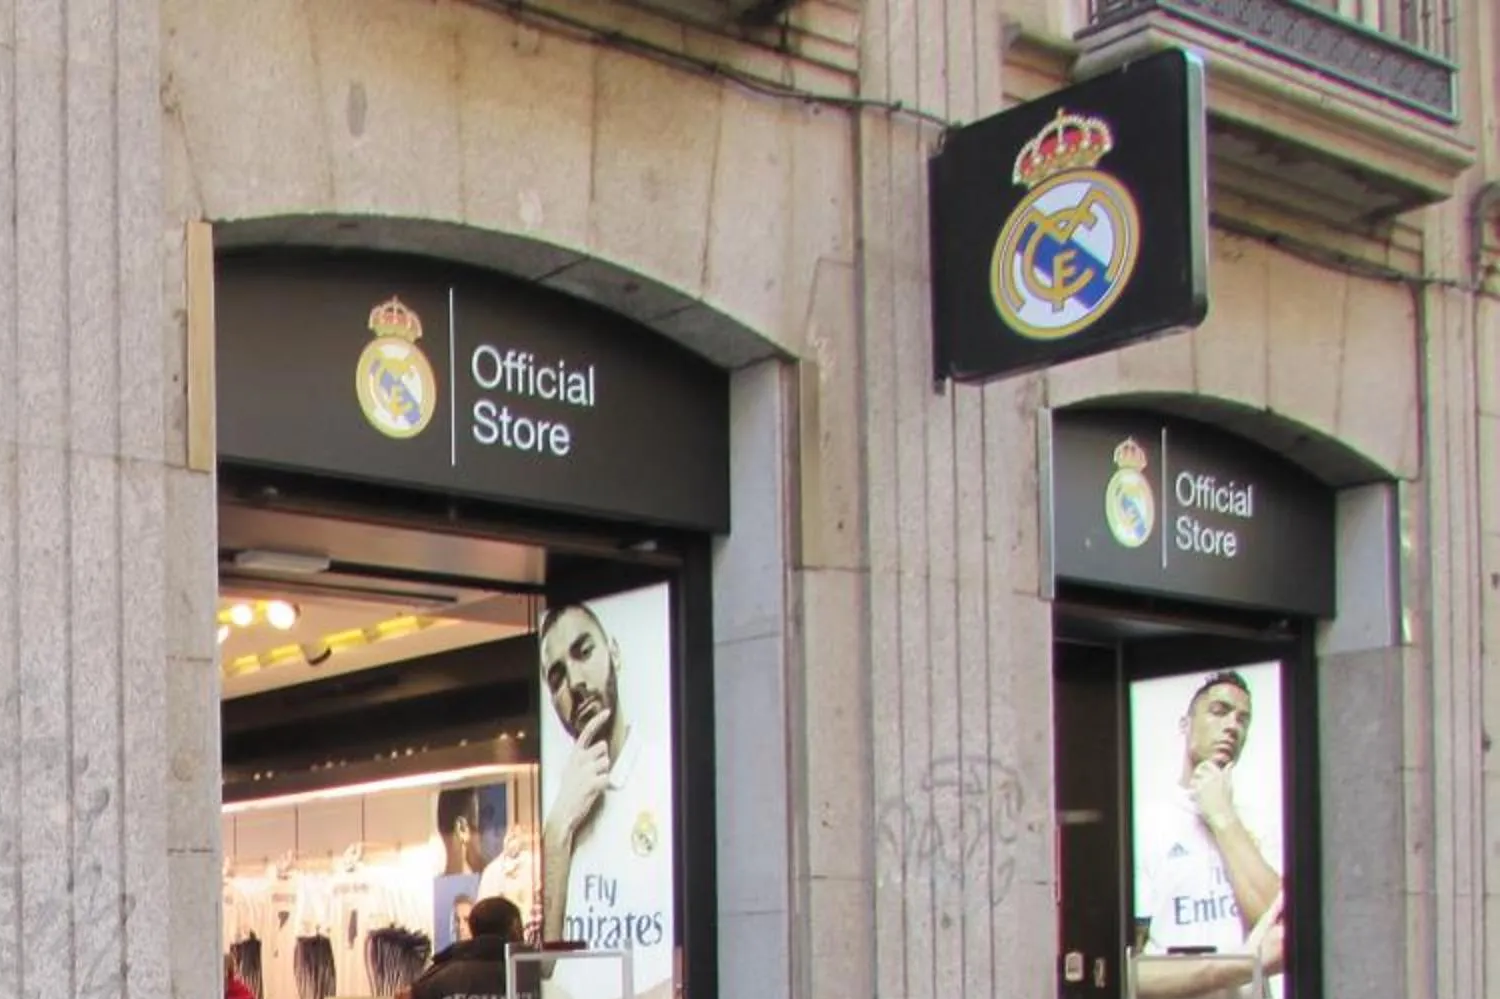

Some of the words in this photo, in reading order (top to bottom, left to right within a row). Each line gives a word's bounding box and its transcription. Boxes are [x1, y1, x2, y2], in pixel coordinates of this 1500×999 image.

[472, 345, 596, 407] Official
[472, 400, 571, 456] Store
[1175, 471, 1254, 518] Official
[1175, 516, 1237, 558] Store
[584, 873, 617, 908] Fly
[1172, 890, 1238, 926] Emira
[564, 905, 663, 947] mirates
